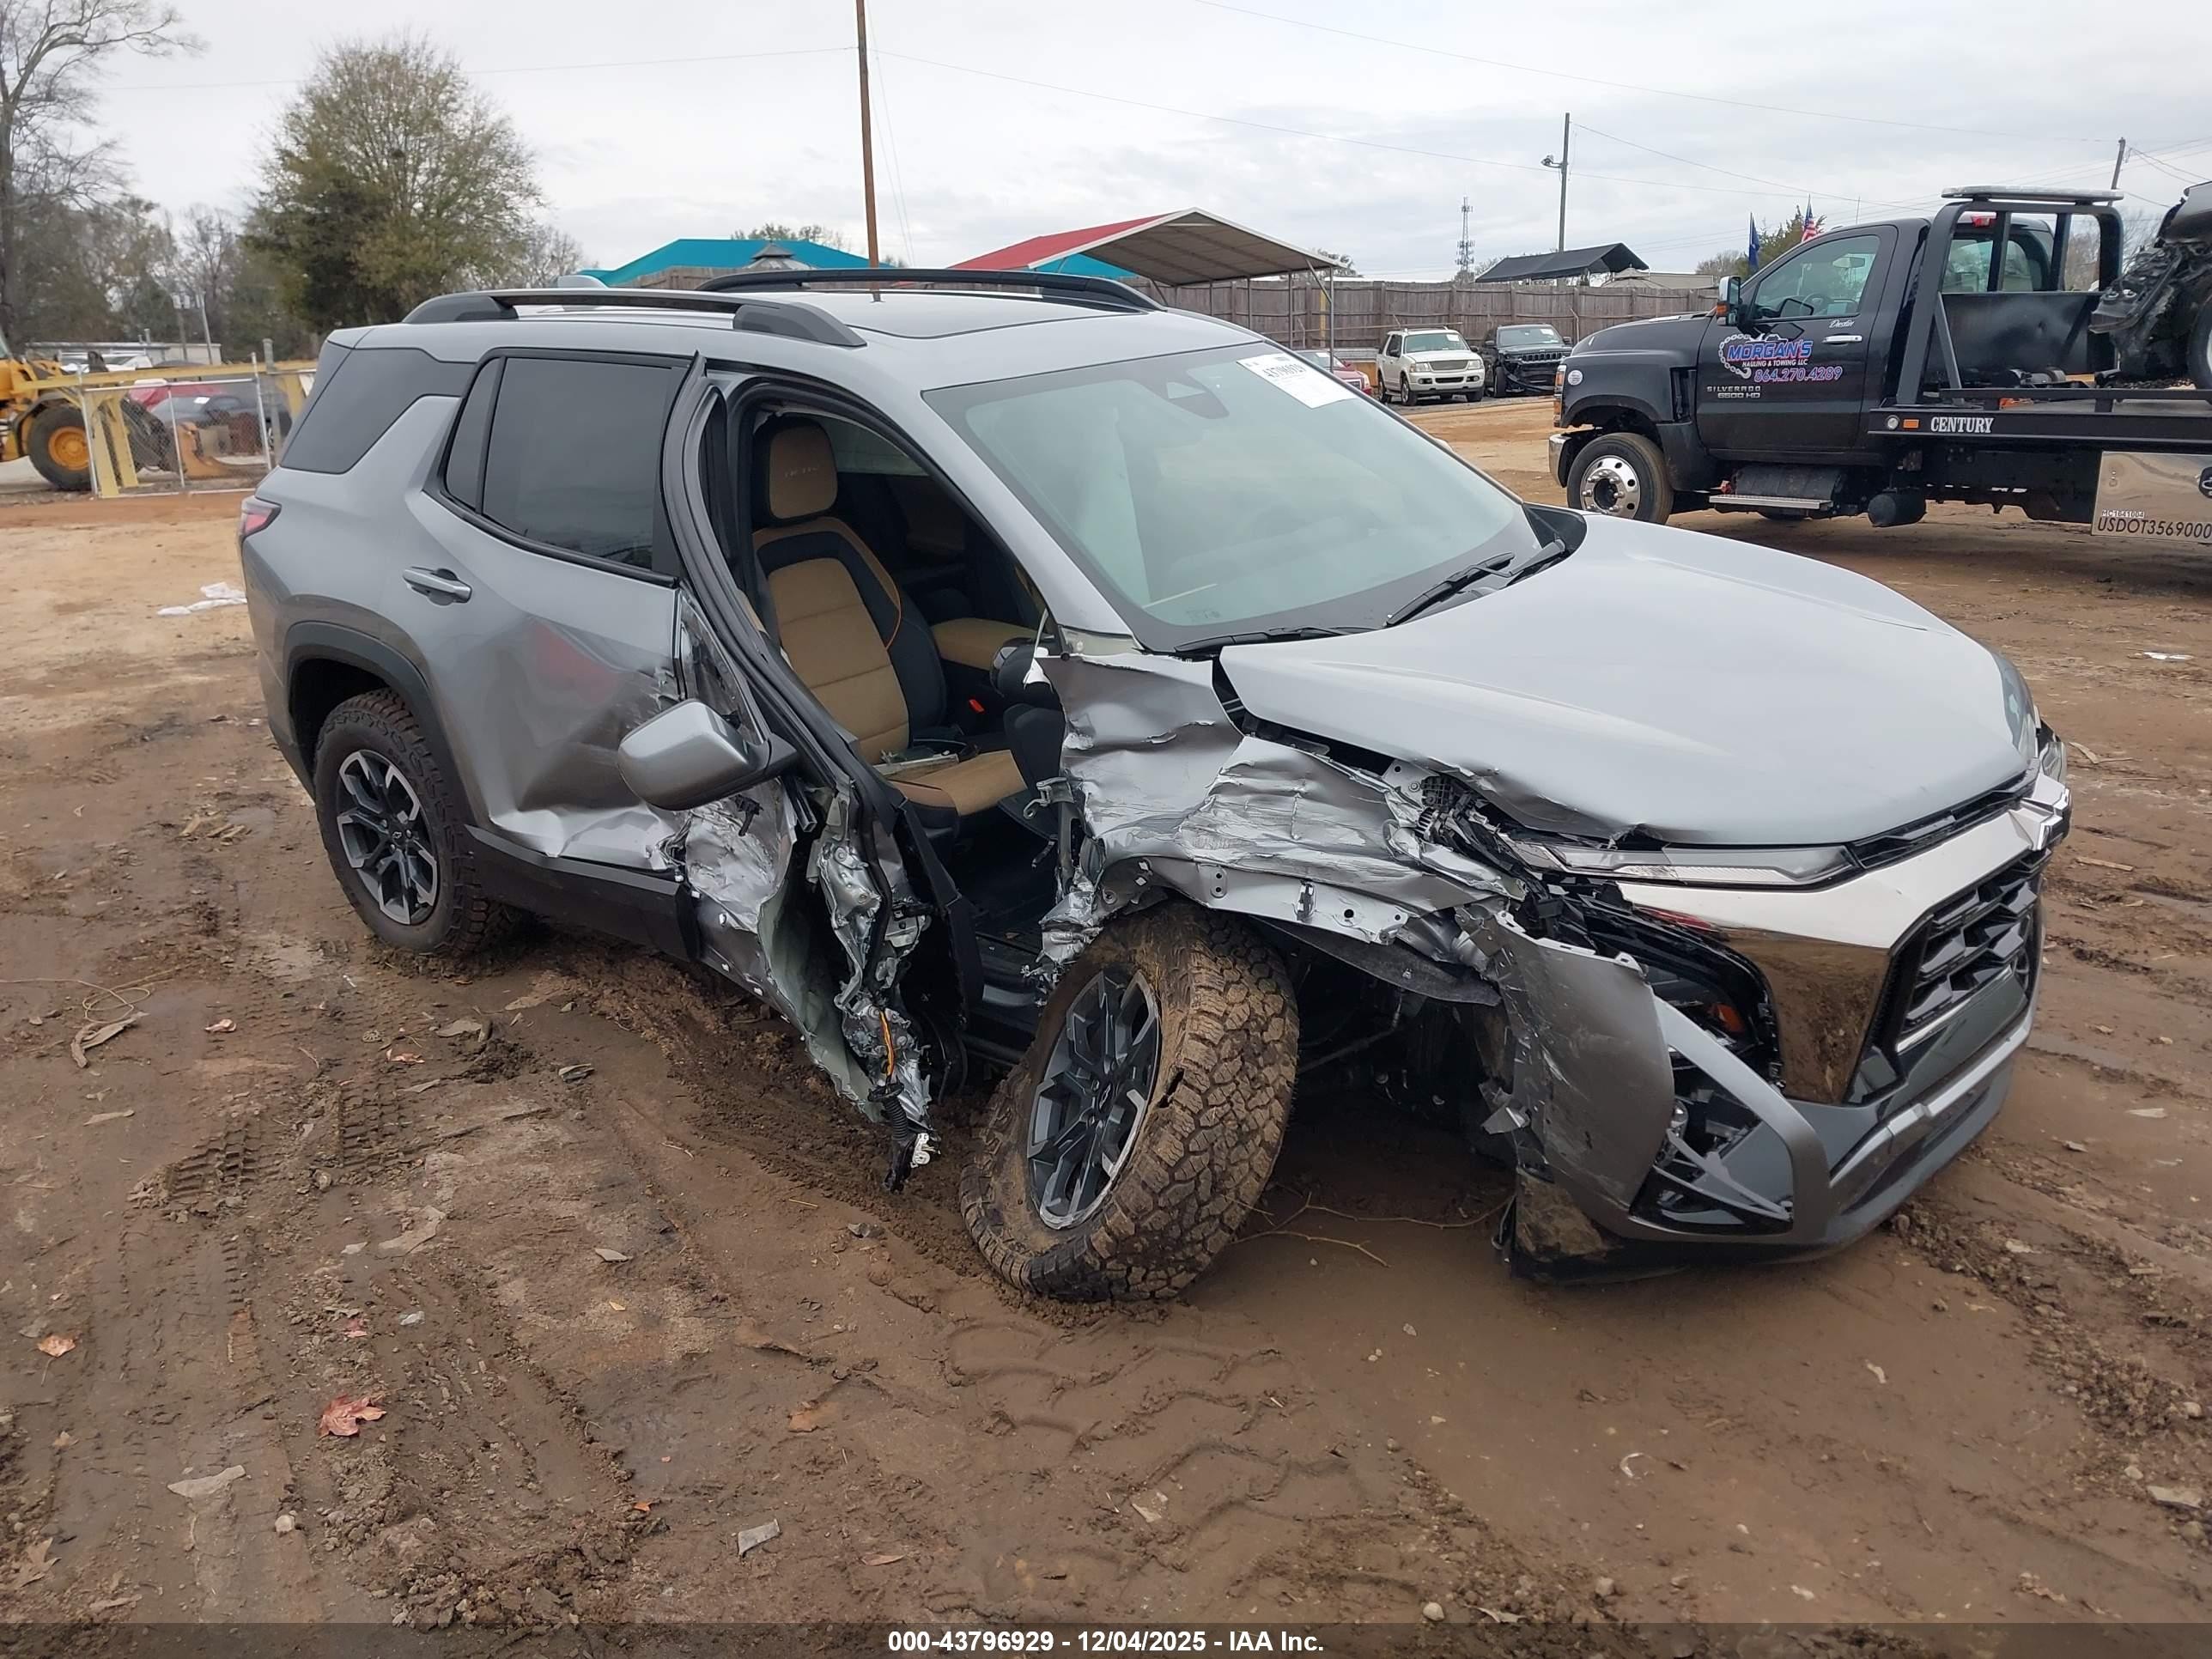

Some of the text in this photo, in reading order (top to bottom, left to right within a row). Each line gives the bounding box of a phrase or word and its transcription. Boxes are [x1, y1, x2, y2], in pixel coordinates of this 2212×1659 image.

[1727, 340, 1814, 362] MORGAN'S
[1753, 367, 1843, 383] 864.270.4289
[1930, 416, 1995, 433] CENTURY
[2098, 517, 2212, 538] USDOT3569000
